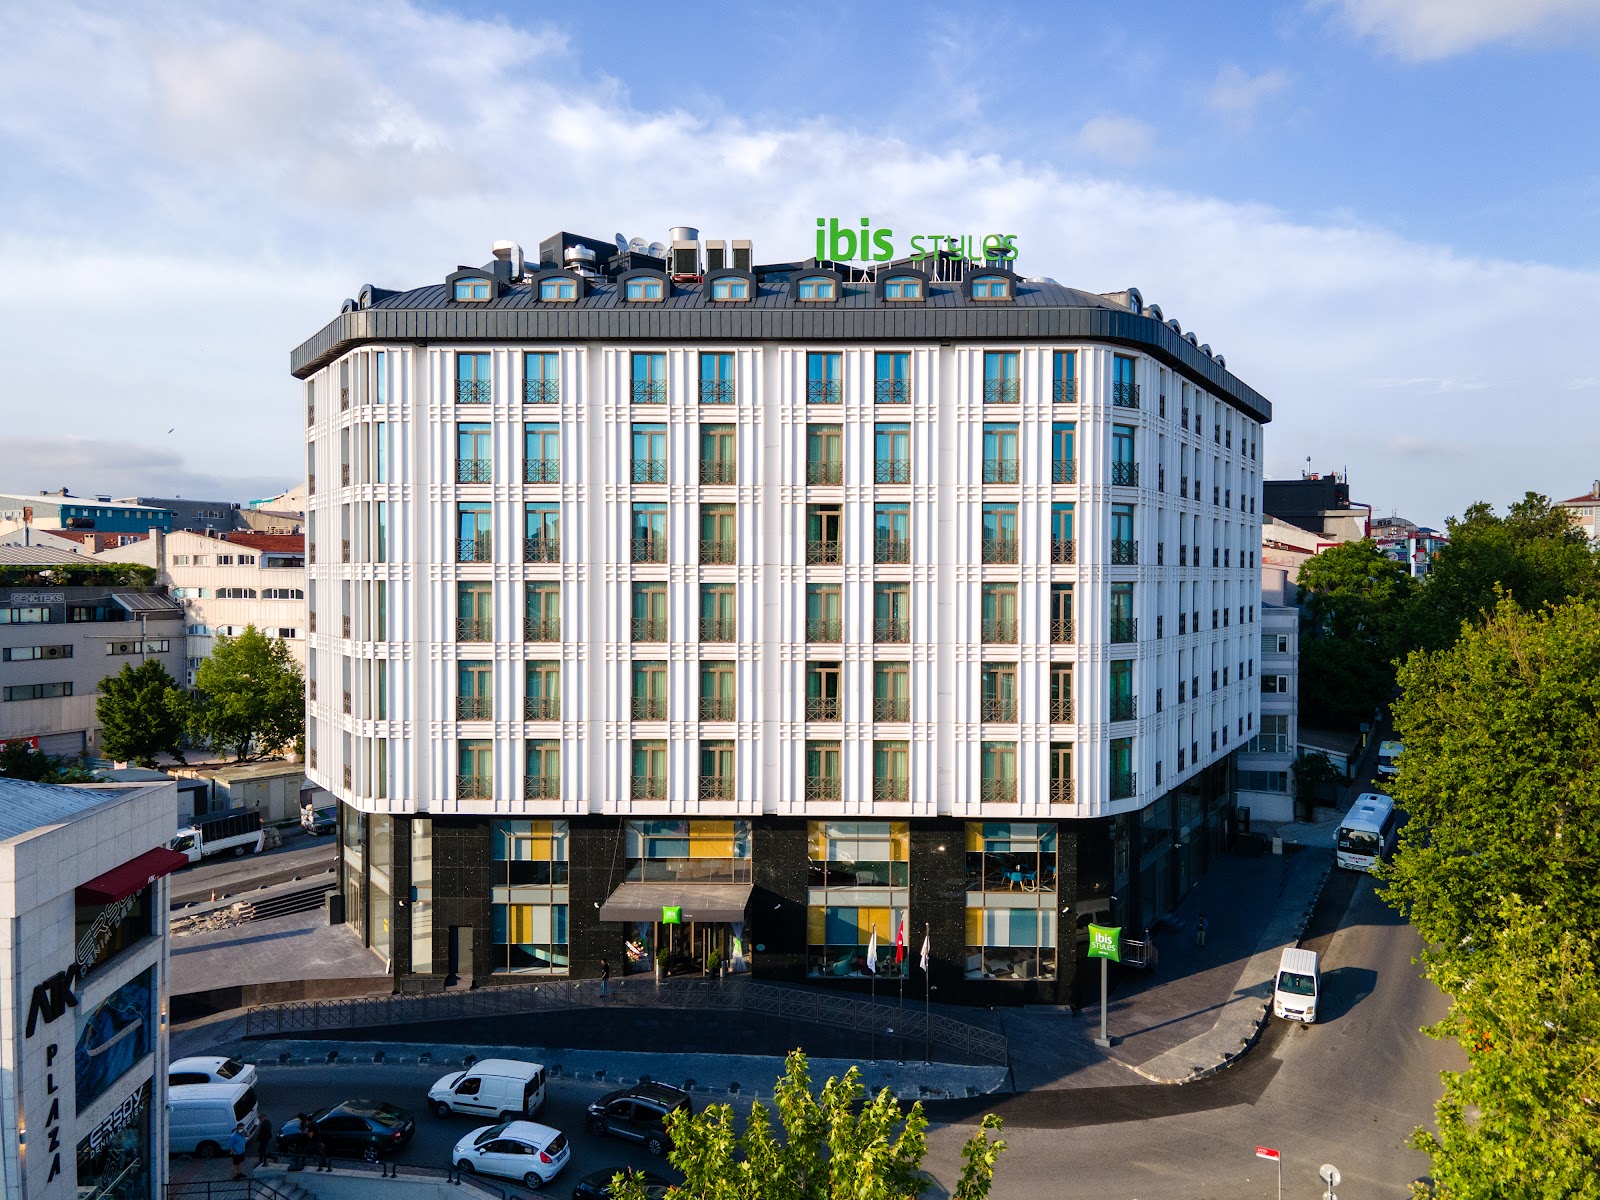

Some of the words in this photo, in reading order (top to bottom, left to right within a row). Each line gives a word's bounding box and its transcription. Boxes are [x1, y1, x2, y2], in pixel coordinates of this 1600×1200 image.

[816, 217, 895, 262] ibis
[1095, 932, 1112, 945] ibis
[26, 961, 79, 1039] ATK
[45, 1043, 61, 1184] PLAZA
[90, 1085, 144, 1149] ERSOY
[90, 1130, 115, 1159] DENIM
[117, 1102, 144, 1133] DESIGN
